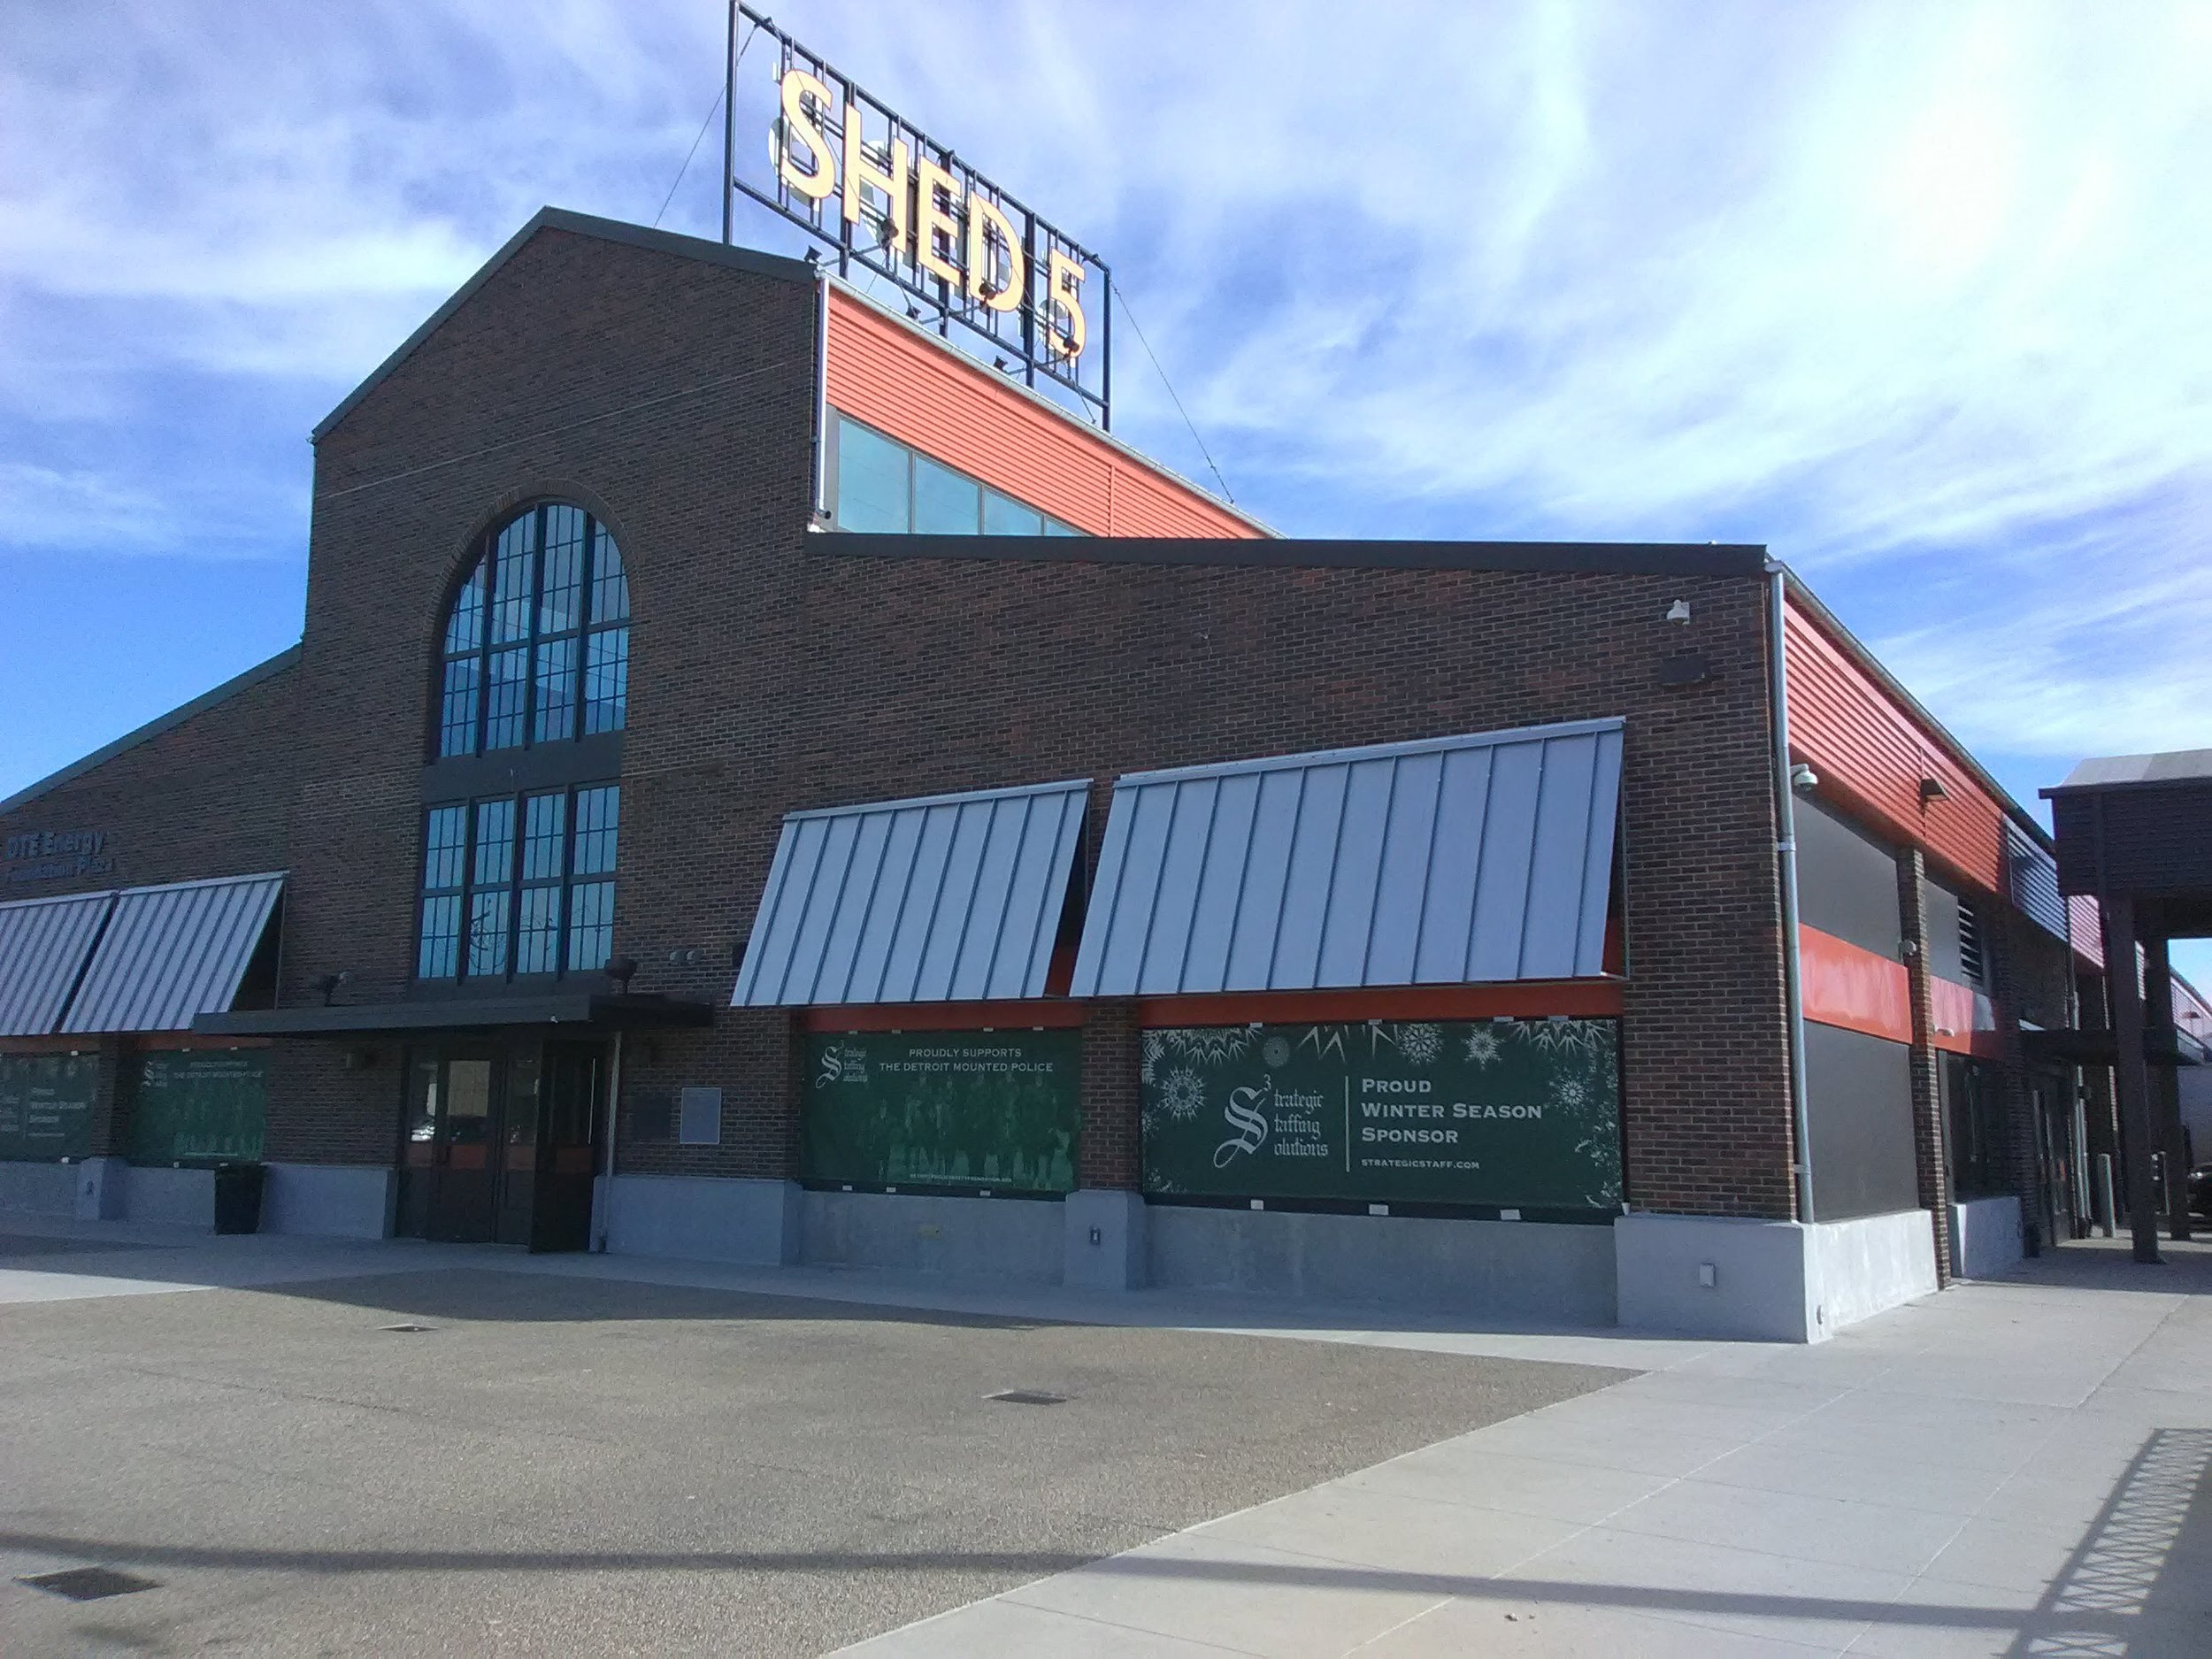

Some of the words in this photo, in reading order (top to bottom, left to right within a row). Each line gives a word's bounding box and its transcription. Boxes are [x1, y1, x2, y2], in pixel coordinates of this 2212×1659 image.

[781, 68, 1025, 312] SHED
[1050, 247, 1087, 358] 5
[909, 1048, 960, 1058] PROUDLY
[963, 1048, 1022, 1058] SUPPORTS
[879, 1062, 901, 1072] THE
[903, 1062, 949, 1072] DETROIT
[953, 1062, 1009, 1072] MOUNTED
[1010, 1062, 1054, 1072] POLICE
[1362, 1078, 1432, 1093] PROUD
[1361, 1102, 1445, 1118] WINTER
[1452, 1102, 1542, 1119] SEASON
[1362, 1126, 1459, 1143] SPONSOR
